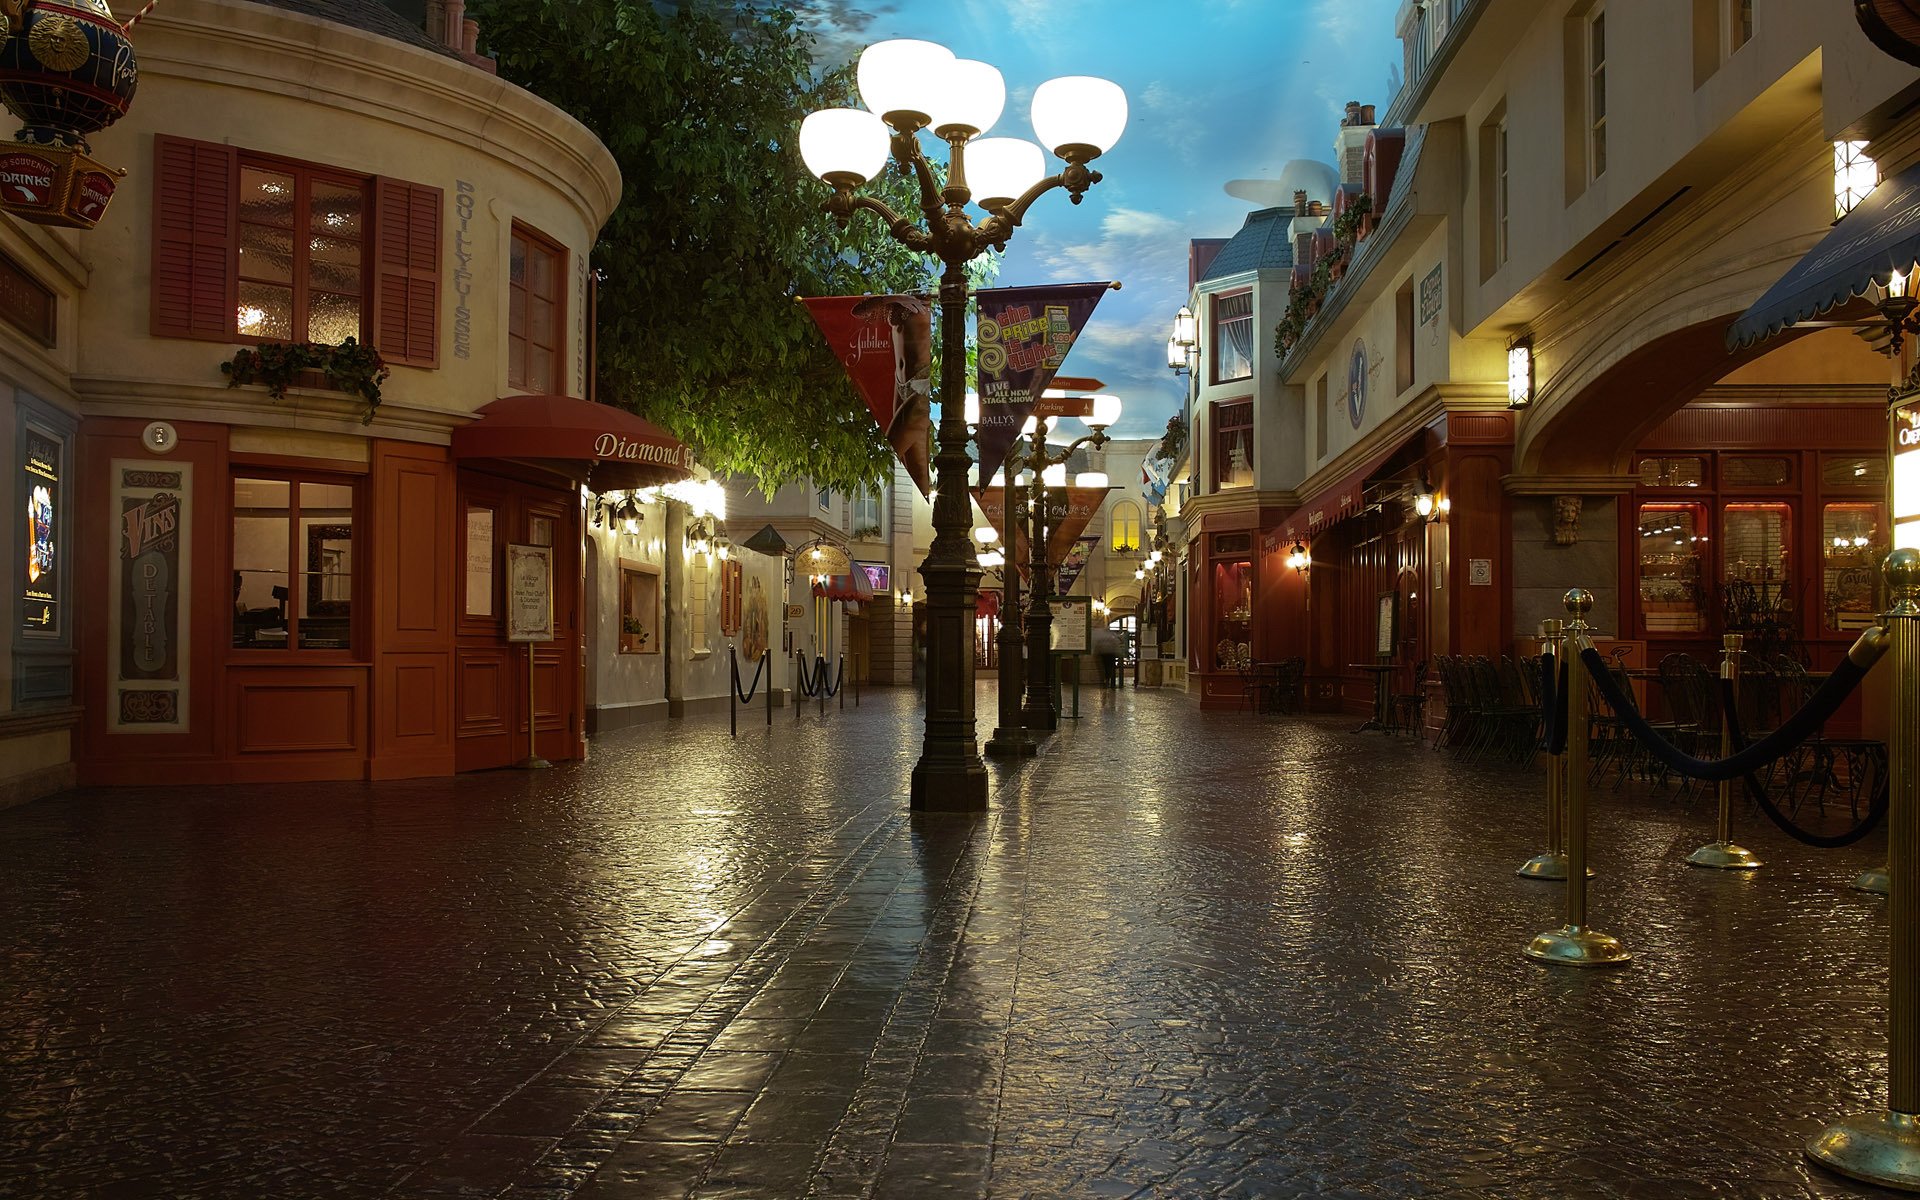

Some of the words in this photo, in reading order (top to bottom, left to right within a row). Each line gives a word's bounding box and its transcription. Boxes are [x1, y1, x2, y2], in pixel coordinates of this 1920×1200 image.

[10, 158, 51, 175] SOUVENIR
[0, 171, 51, 188] DRINKS
[82, 186, 109, 206] DRINKS
[985, 381, 1010, 395] LIVE
[982, 397, 1007, 405] STAGE
[1009, 395, 1035, 404] SHOW
[1040, 403, 1065, 413] Parking
[982, 415, 1015, 425] BALLY'S
[594, 433, 684, 466] Diamond
